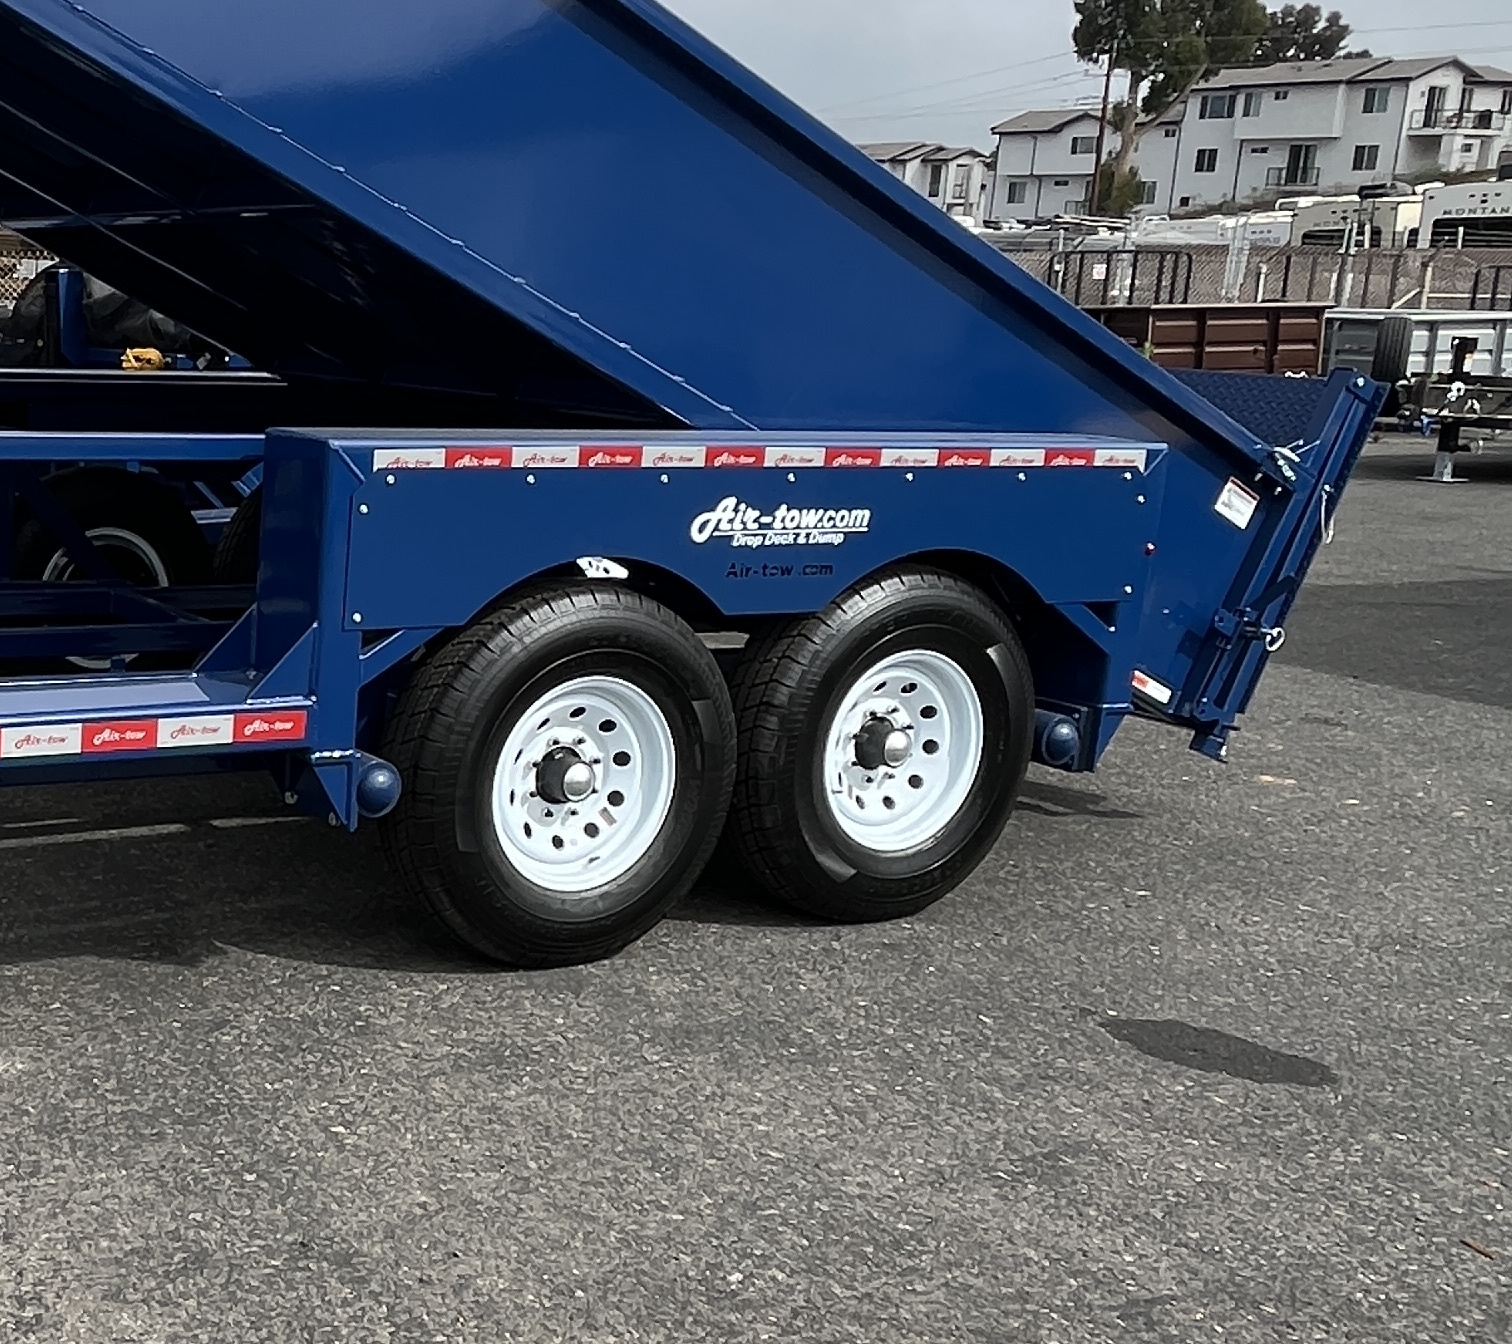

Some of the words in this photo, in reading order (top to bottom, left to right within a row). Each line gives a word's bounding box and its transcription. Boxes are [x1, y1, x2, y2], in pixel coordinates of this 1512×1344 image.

[588, 452, 633, 467] Air-tow
[714, 452, 756, 467] Air-tow
[690, 496, 871, 544] Air-tow.com
[731, 532, 764, 549] Drop
[764, 531, 796, 546] Deck
[796, 532, 807, 545] &
[808, 531, 846, 546] Dump
[14, 734, 69, 749] Air-tow
[92, 728, 147, 746] Air-tow
[170, 724, 221, 739] Air-tow
[243, 718, 294, 736] Air-tow
